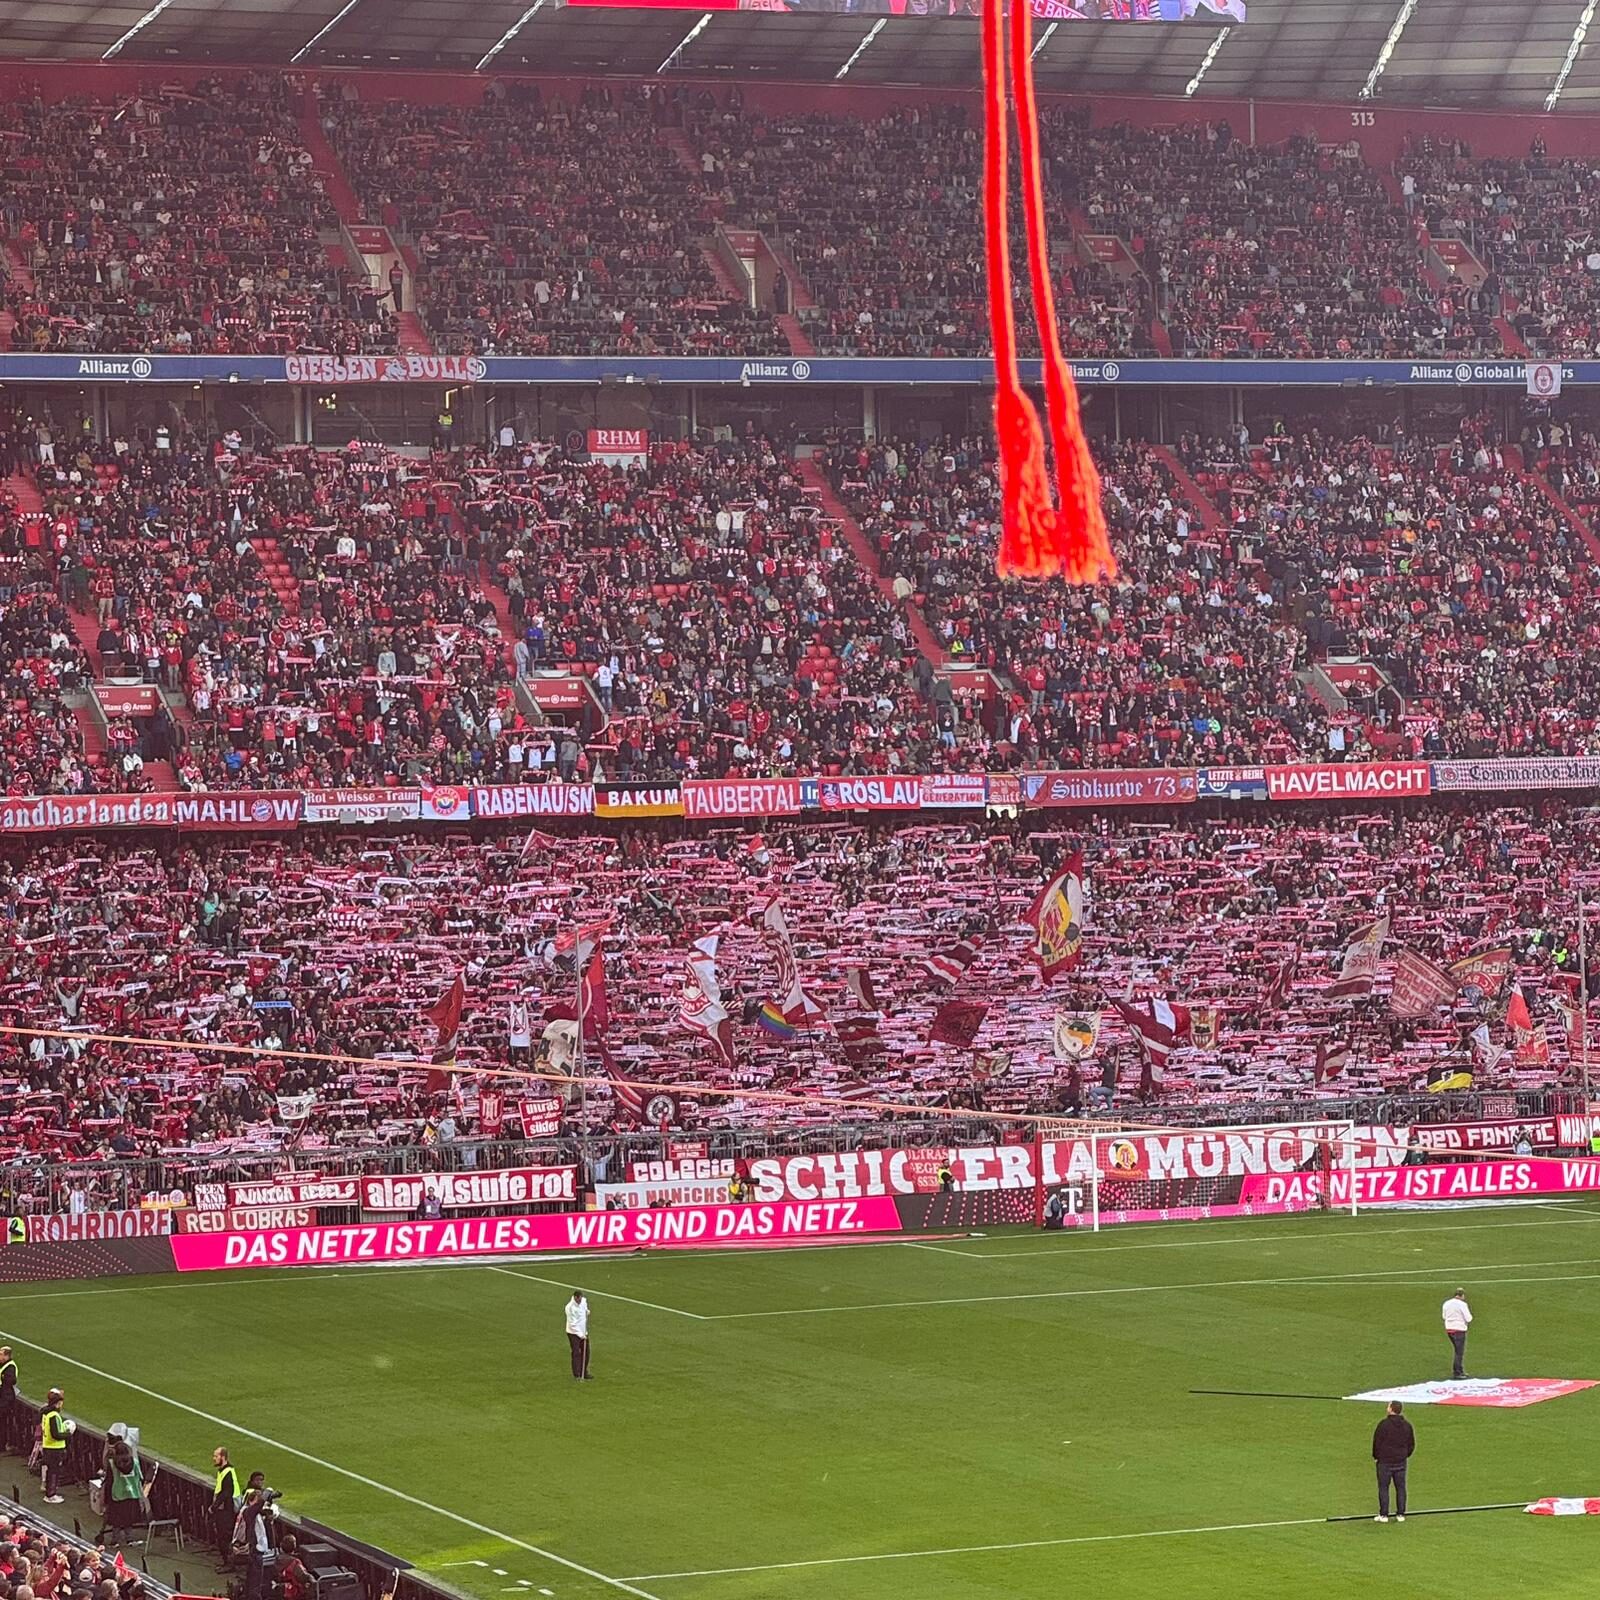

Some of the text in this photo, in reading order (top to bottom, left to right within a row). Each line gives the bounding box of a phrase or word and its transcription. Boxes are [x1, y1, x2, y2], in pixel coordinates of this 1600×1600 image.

[1351, 112, 1375, 126] 313
[79, 359, 129, 374] Allianz
[286, 356, 478, 382] GIESSEN BULLS
[742, 363, 788, 376] Allianz
[1068, 365, 1100, 377] lianz
[1410, 366, 1453, 379] Allianz
[1474, 365, 1514, 379] Global
[597, 431, 641, 446] RHM
[1208, 770, 1234, 781] LETZTE
[1270, 768, 1426, 794] HAVELMACHT
[1470, 764, 1560, 781] Commando
[308, 792, 326, 803] Rot
[337, 791, 376, 802] Weisse
[608, 788, 678, 807] BAKUM
[840, 780, 918, 804] RÖSLAU
[923, 792, 983, 802] GENERATION
[1050, 777, 1145, 801] Südkurve
[477, 785, 592, 816] RABENAU/SN
[684, 783, 800, 815] TAUBERTAL
[0, 797, 168, 828] andharlanden
[525, 1099, 560, 1115] ultras
[1483, 1104, 1513, 1113] JUNGS
[195, 1183, 225, 1194] SEEN
[532, 1168, 574, 1199] rot
[1267, 1161, 1600, 1204] DAS NETZ IST ALLES. WI
[196, 1193, 227, 1203] LAND
[235, 1182, 356, 1205] MUNICH REBELS
[197, 1202, 228, 1211] FRONT
[29, 1208, 171, 1243] ROHRDORF
[186, 1208, 310, 1233] RED COBRAS
[225, 1202, 864, 1264] DAS NETZ IST ALLES. WIR SIND DAS NETZ.
